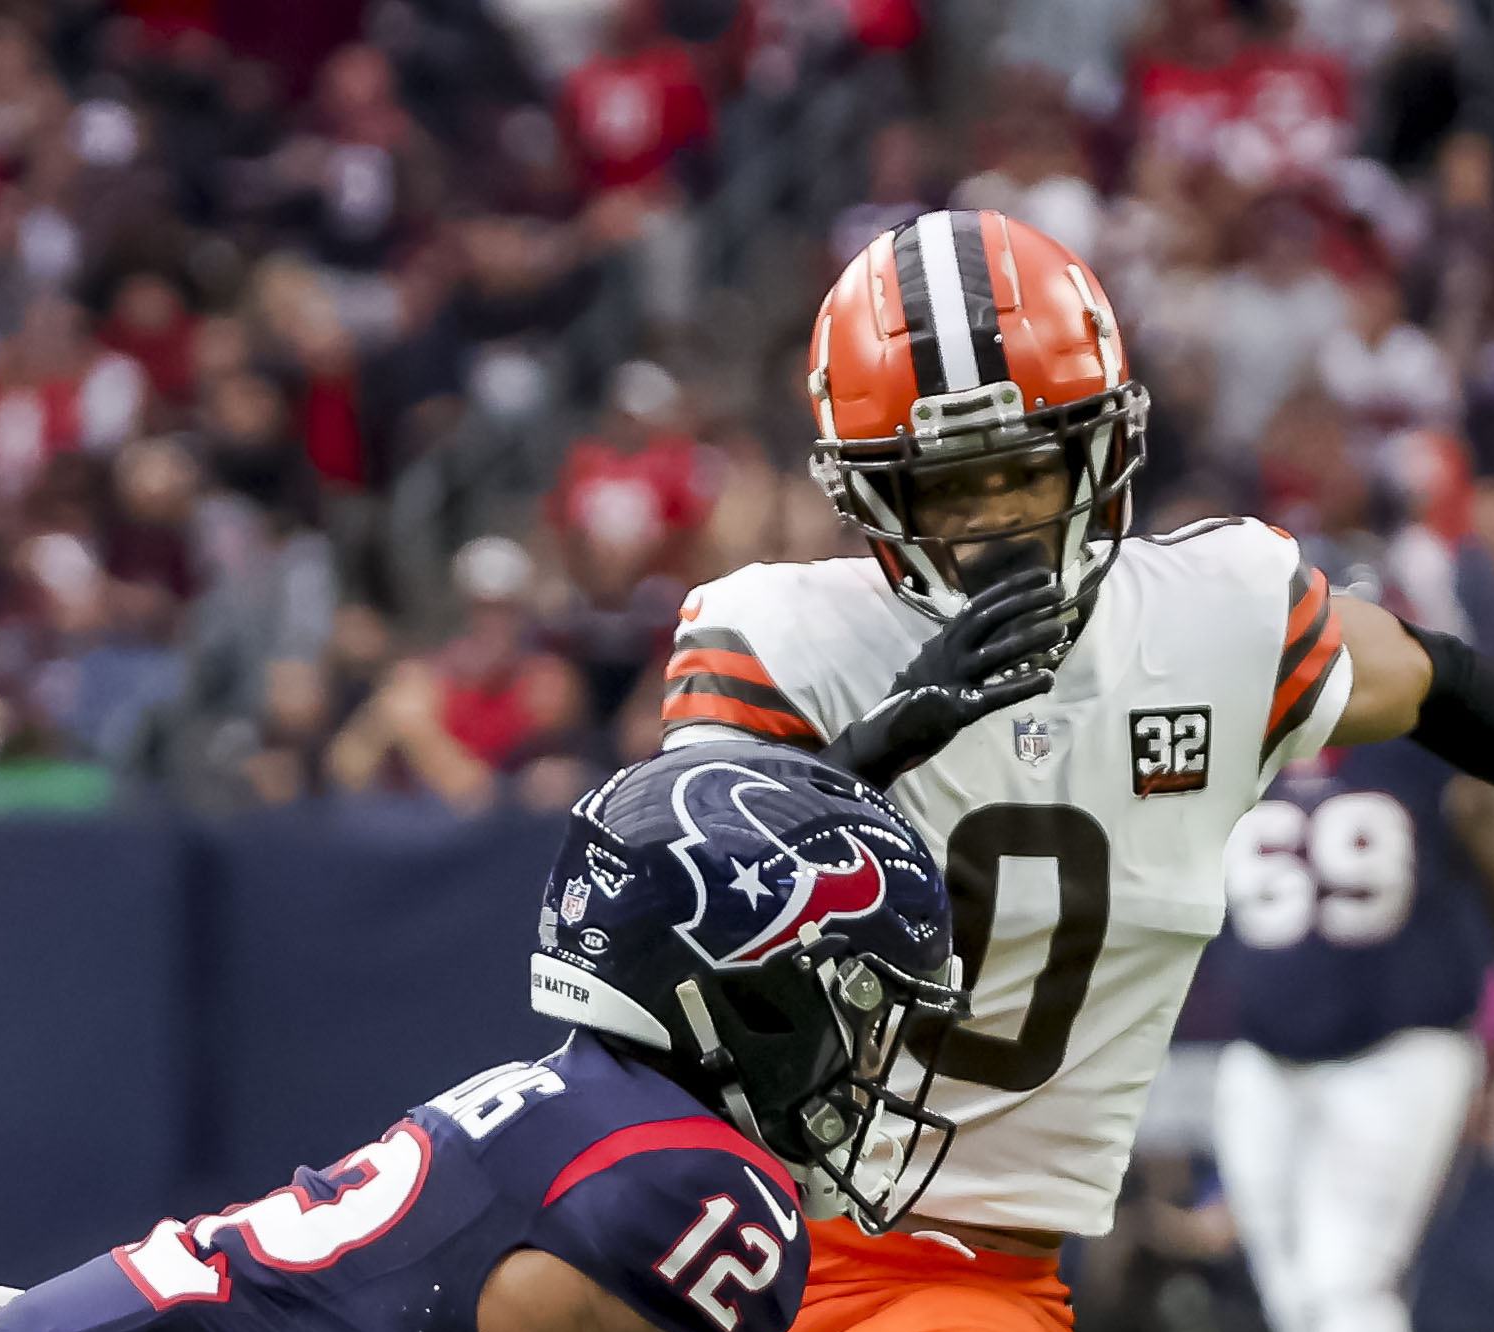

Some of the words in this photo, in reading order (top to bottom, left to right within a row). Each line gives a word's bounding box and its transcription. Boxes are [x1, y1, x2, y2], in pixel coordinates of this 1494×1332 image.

[1135, 713, 1207, 775] 32
[910, 802, 1110, 1092] 0
[544, 975, 590, 1004] MATTER
